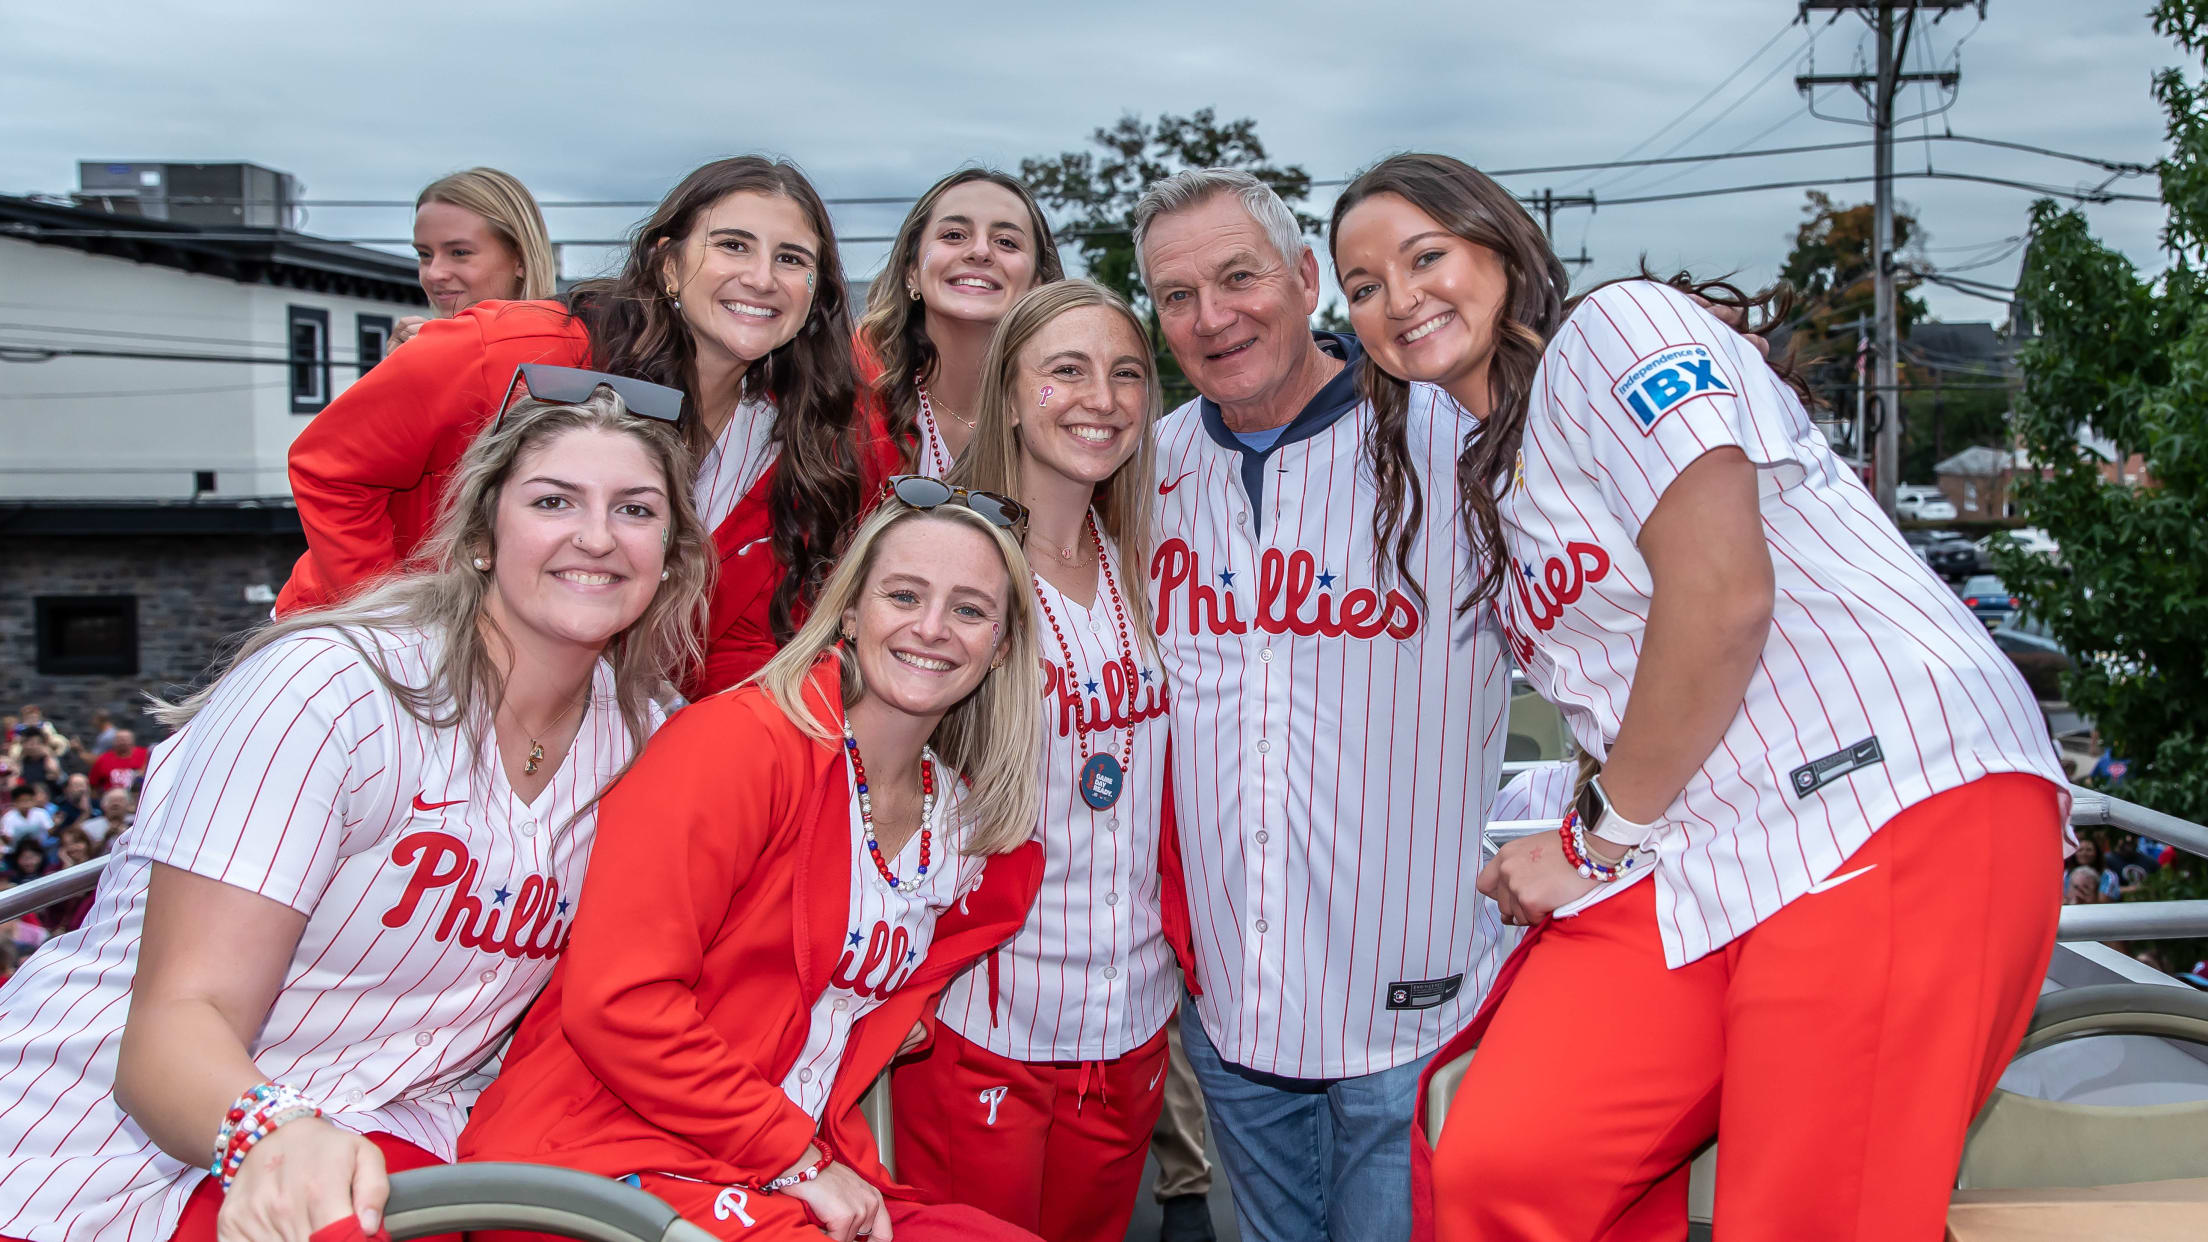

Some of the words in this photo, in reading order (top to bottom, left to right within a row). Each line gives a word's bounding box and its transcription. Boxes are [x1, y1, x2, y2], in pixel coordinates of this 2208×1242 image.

[1617, 348, 1694, 395] Independence
[1040, 385, 1055, 406] P
[1626, 359, 1731, 427] IBX
[1150, 537, 1420, 640] Phillies
[1094, 779, 1107, 788] DAY
[1095, 773, 1113, 785] GAME
[381, 830, 574, 961] Philli
[978, 1086, 1009, 1126] P
[713, 1187, 756, 1228] P
